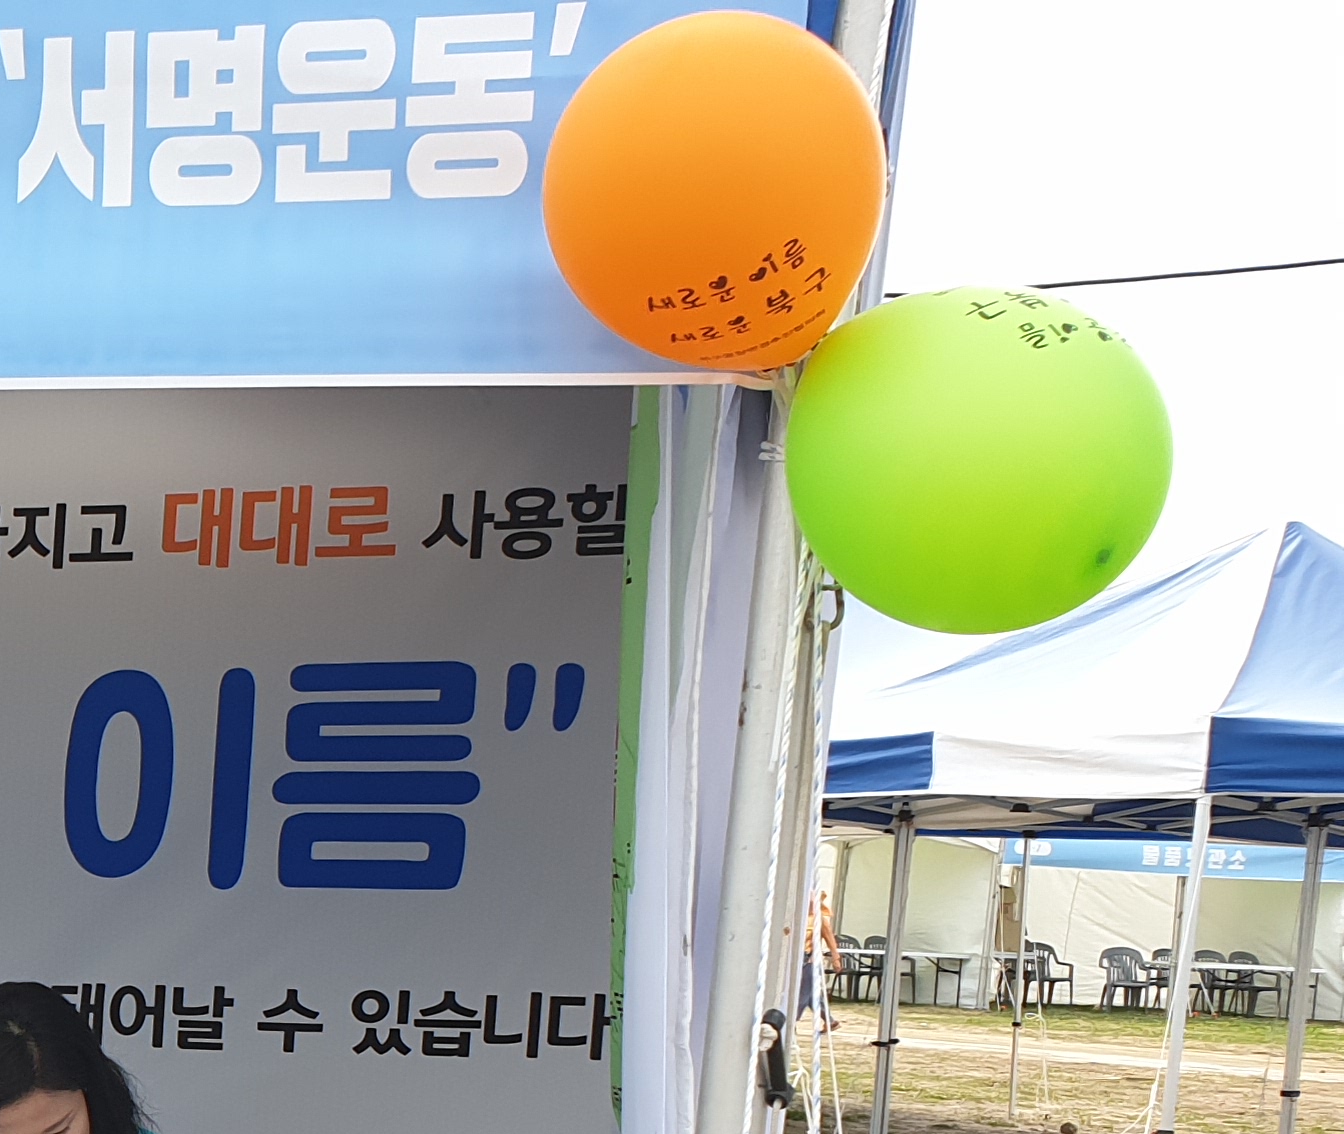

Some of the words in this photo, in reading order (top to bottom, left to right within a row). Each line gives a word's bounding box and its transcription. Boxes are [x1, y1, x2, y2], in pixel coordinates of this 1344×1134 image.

[648, 275, 736, 312] 새로운
[749, 238, 806, 283] 이름
[671, 316, 751, 343] 새로운
[161, 484, 397, 569] 대대로
[1142, 845, 1247, 870] 물품관소
[257, 989, 324, 1053] 수
